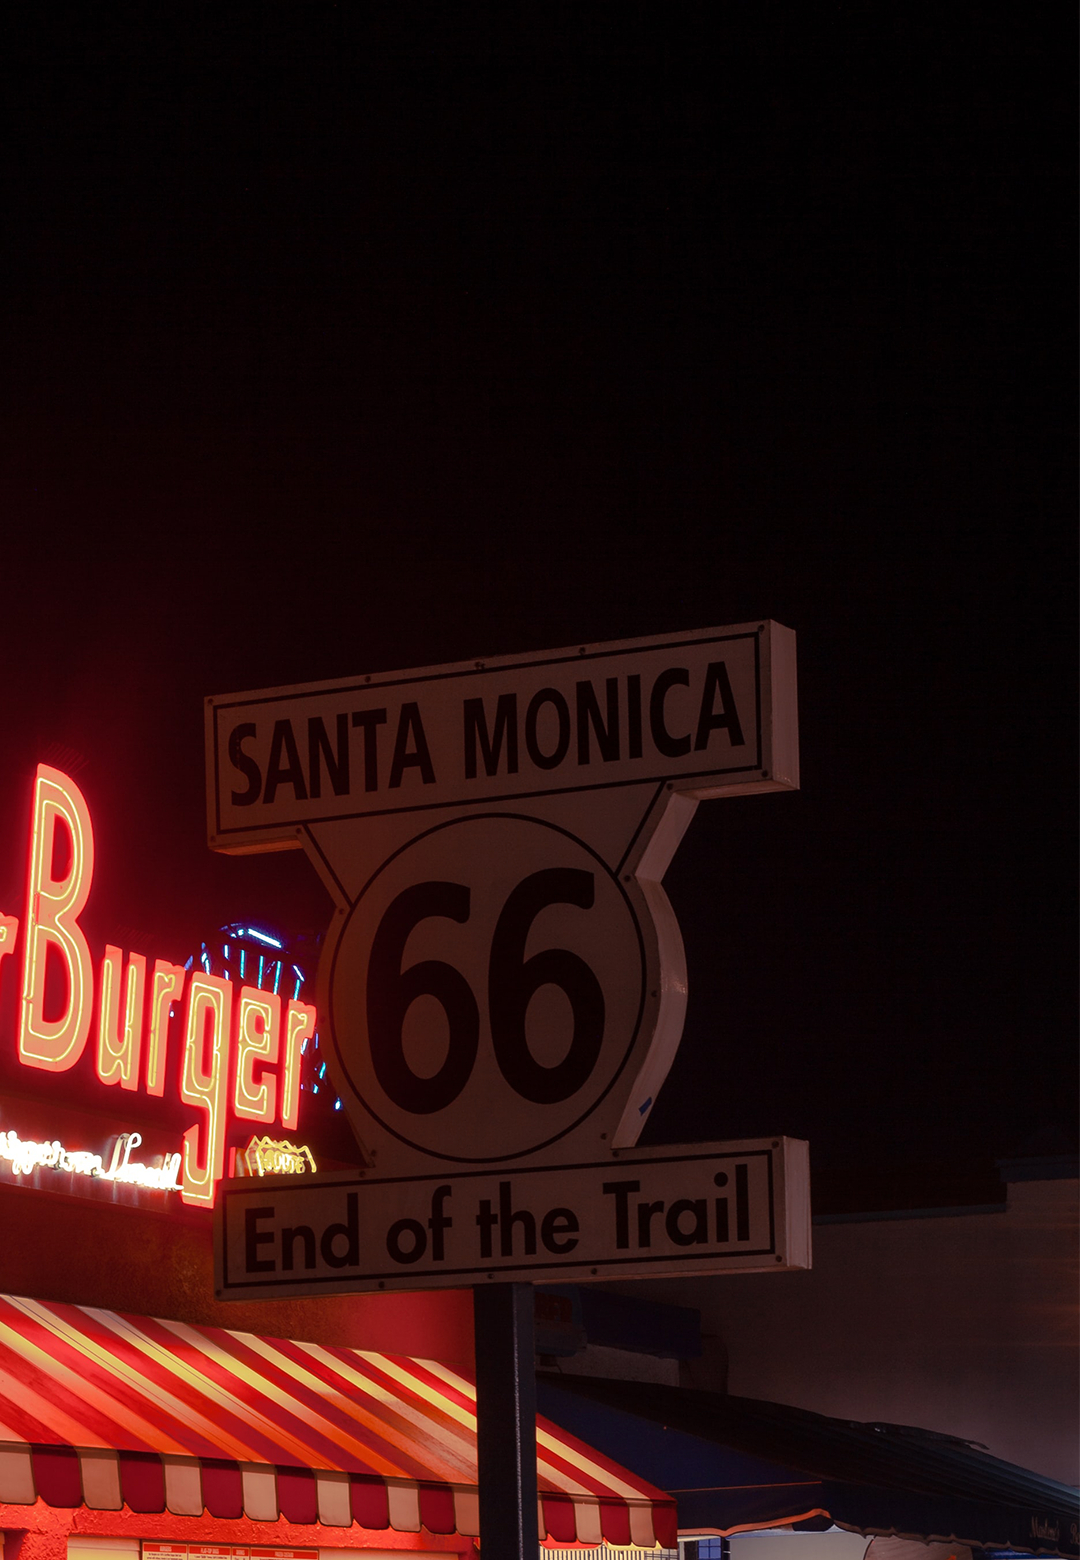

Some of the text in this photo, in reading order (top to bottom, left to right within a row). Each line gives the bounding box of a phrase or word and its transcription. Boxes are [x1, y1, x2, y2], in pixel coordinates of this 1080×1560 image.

[228, 659, 747, 809] SANTA MONICA
[365, 866, 606, 1116] 66
[244, 1163, 750, 1274] End of the Trail
